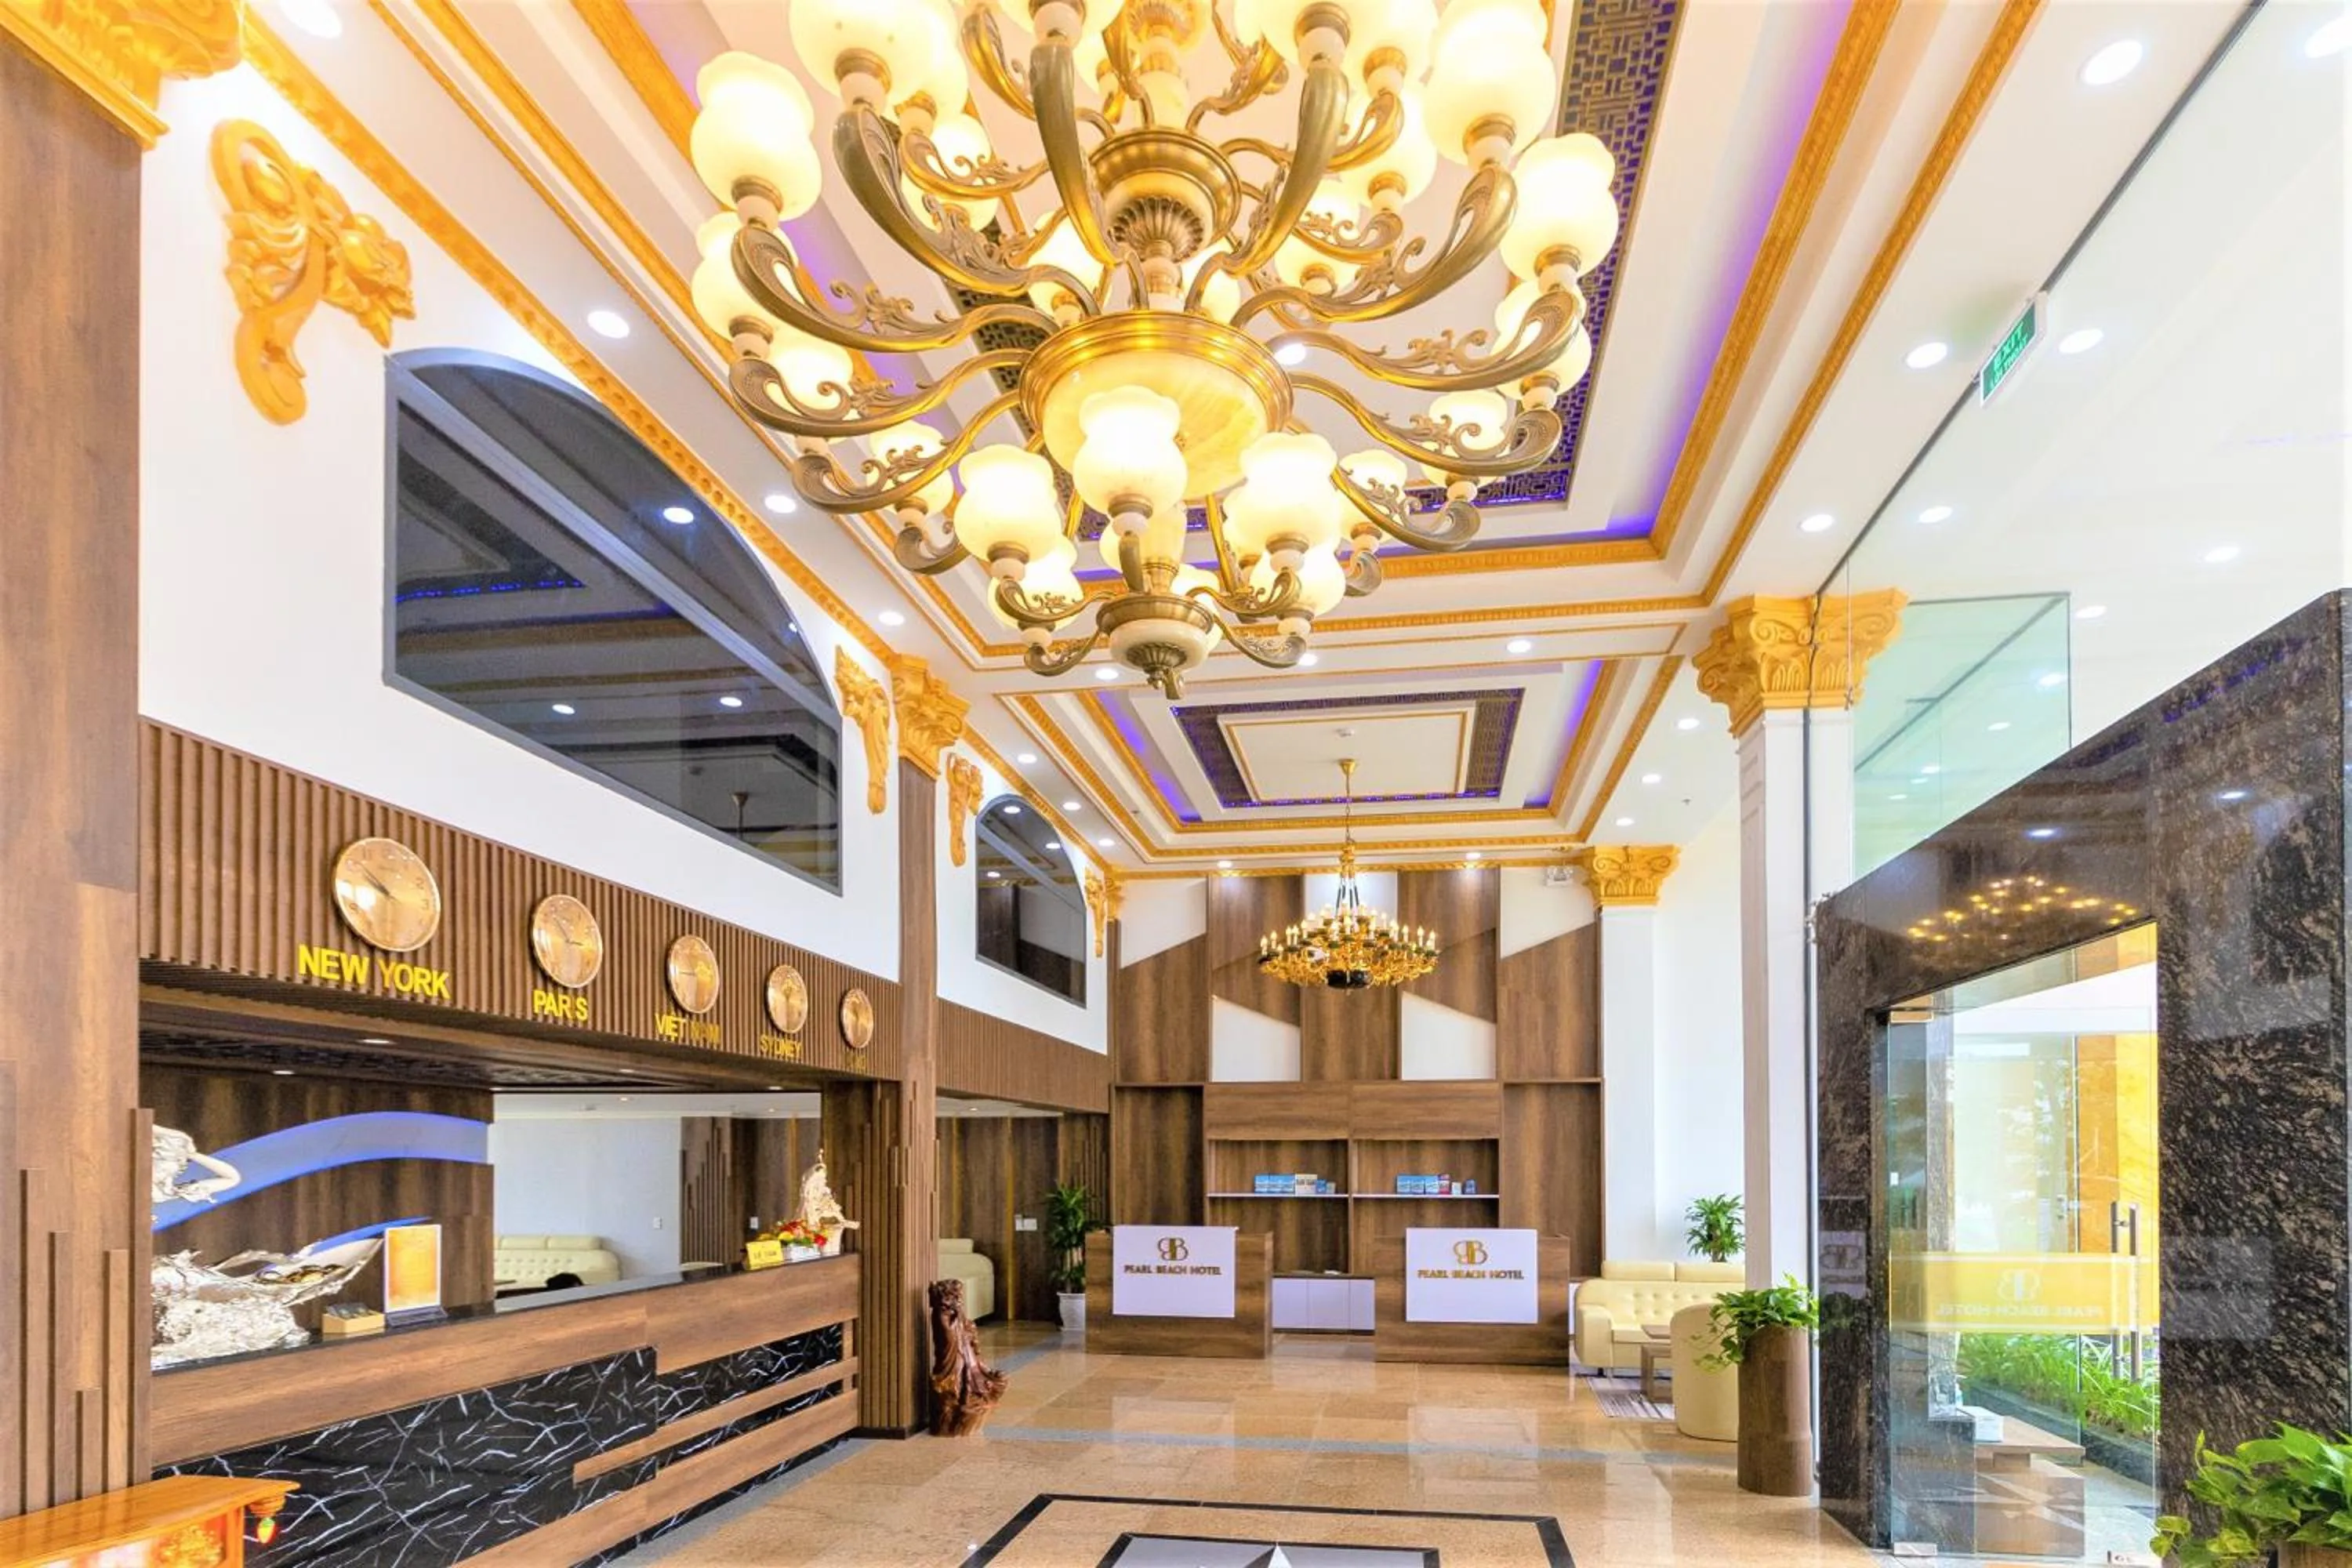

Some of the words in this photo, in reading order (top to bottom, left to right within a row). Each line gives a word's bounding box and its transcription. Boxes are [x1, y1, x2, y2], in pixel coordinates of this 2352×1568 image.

[1994, 321, 2024, 370] EXIT
[299, 944, 369, 985] NEW
[377, 959, 451, 1000] YORK
[1124, 1265, 1152, 1274] PEARL
[1156, 1265, 1187, 1275] BEACH
[1190, 1266, 1221, 1276] HOTEL
[1417, 1269, 1448, 1279] PEARL
[1452, 1269, 1486, 1279] BEACH
[1490, 1270, 1524, 1279] HOTEL
